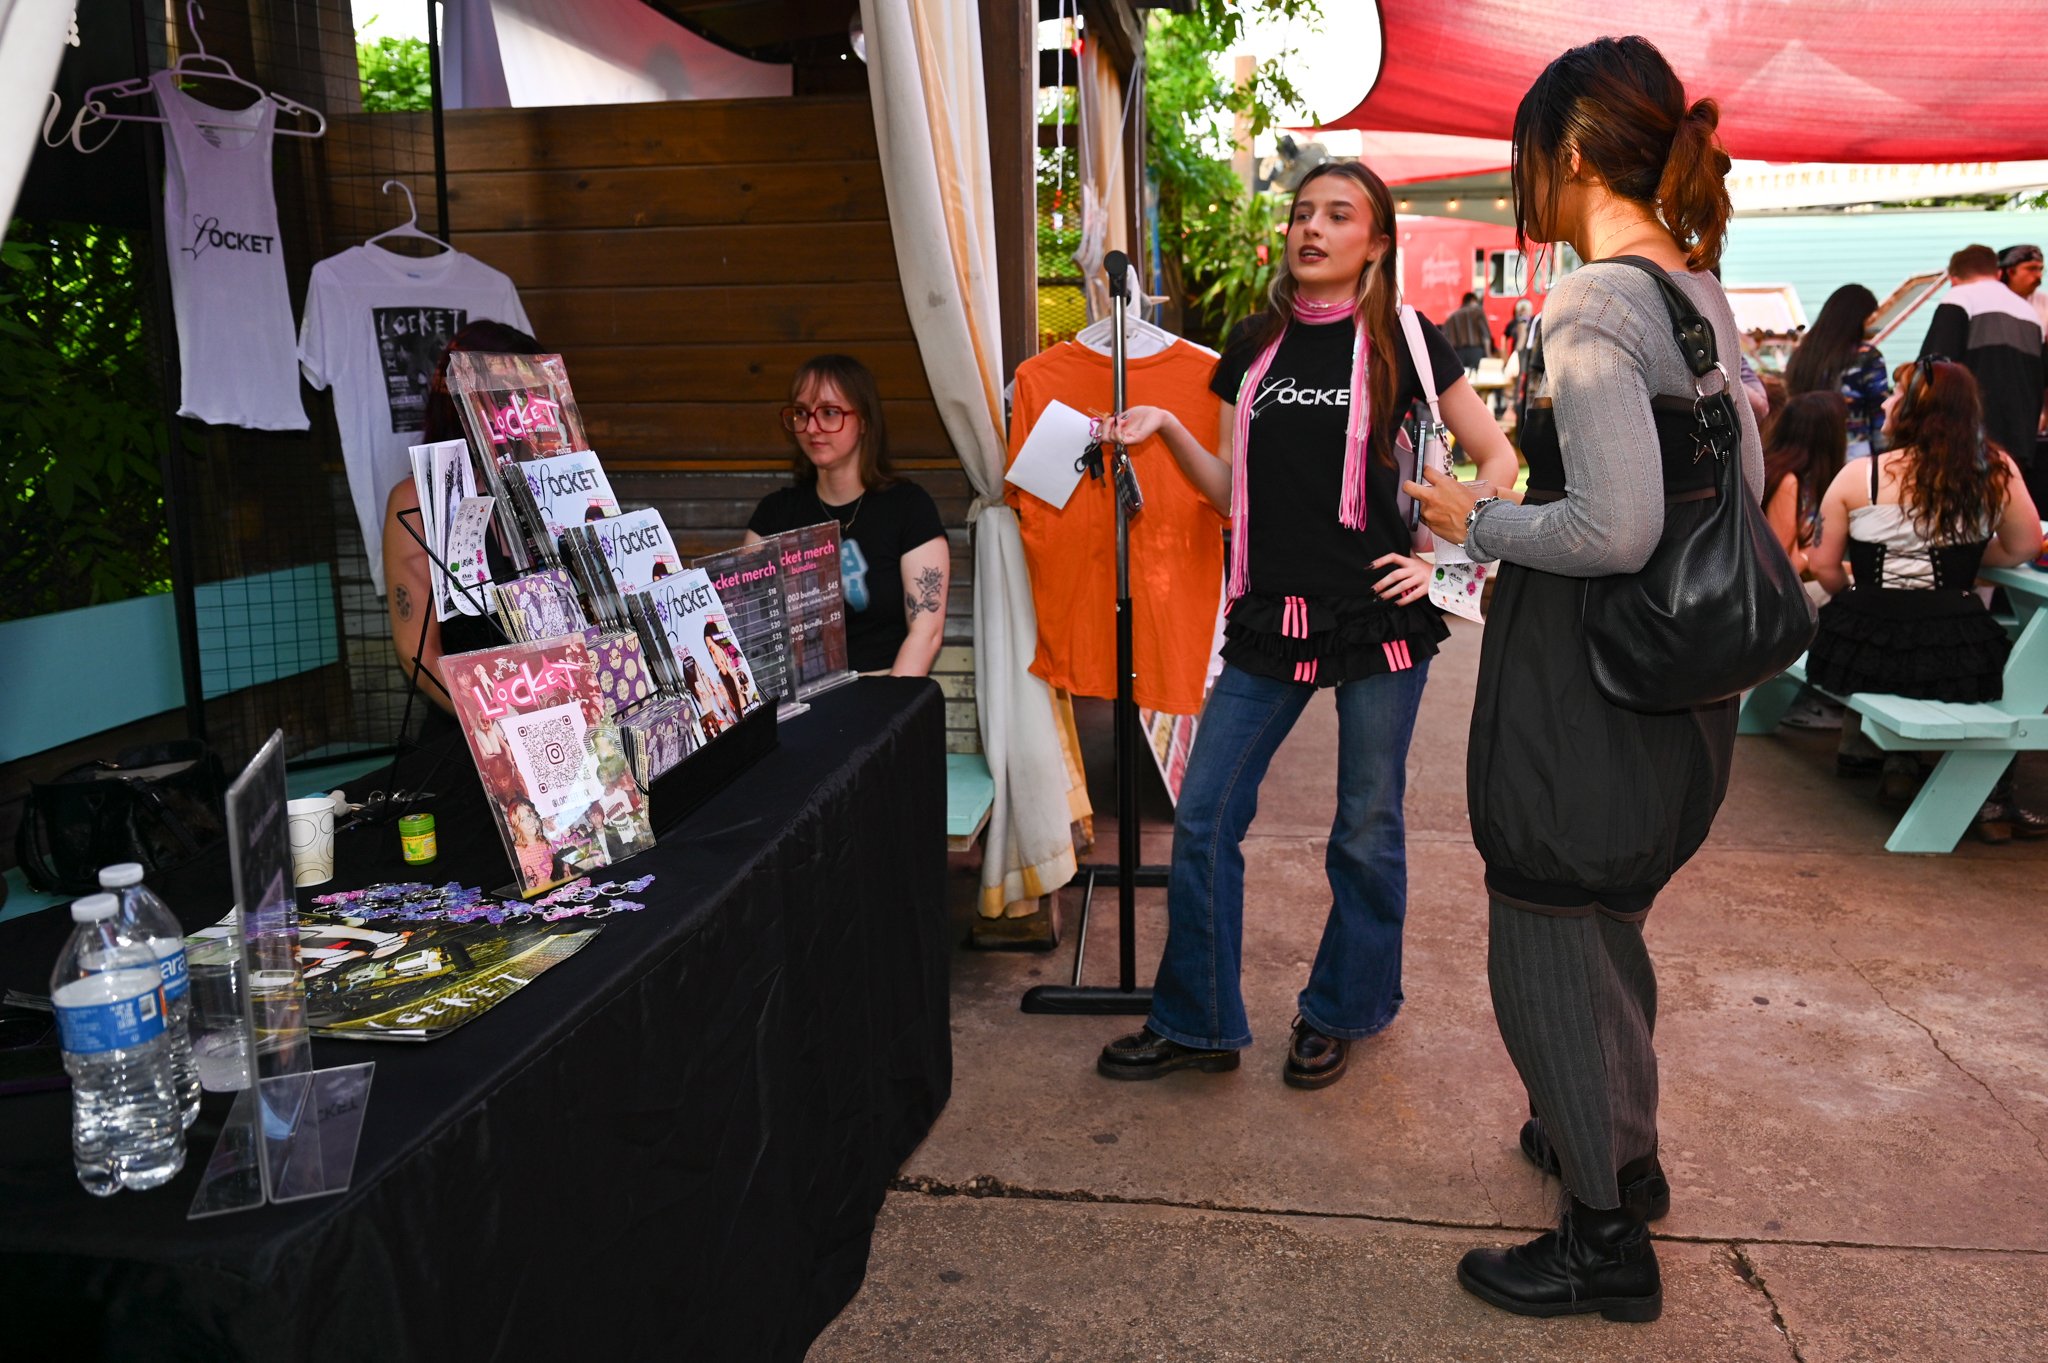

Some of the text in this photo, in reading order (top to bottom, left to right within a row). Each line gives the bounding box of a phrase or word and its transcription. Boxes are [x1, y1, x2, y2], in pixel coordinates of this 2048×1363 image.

[181, 213, 274, 260] LOCKET
[380, 309, 462, 339] LOCKET
[481, 394, 560, 441] LOCKET
[1250, 377, 1351, 420] LOCKE
[531, 463, 599, 519] LOCKET
[605, 521, 662, 579] LOCKET
[742, 561, 777, 584] merch
[791, 562, 817, 575] bundles
[804, 540, 835, 558] merch
[660, 585, 713, 642] LOCKET
[473, 662, 581, 717] LOCKET
[366, 971, 530, 1028] LOCKET
